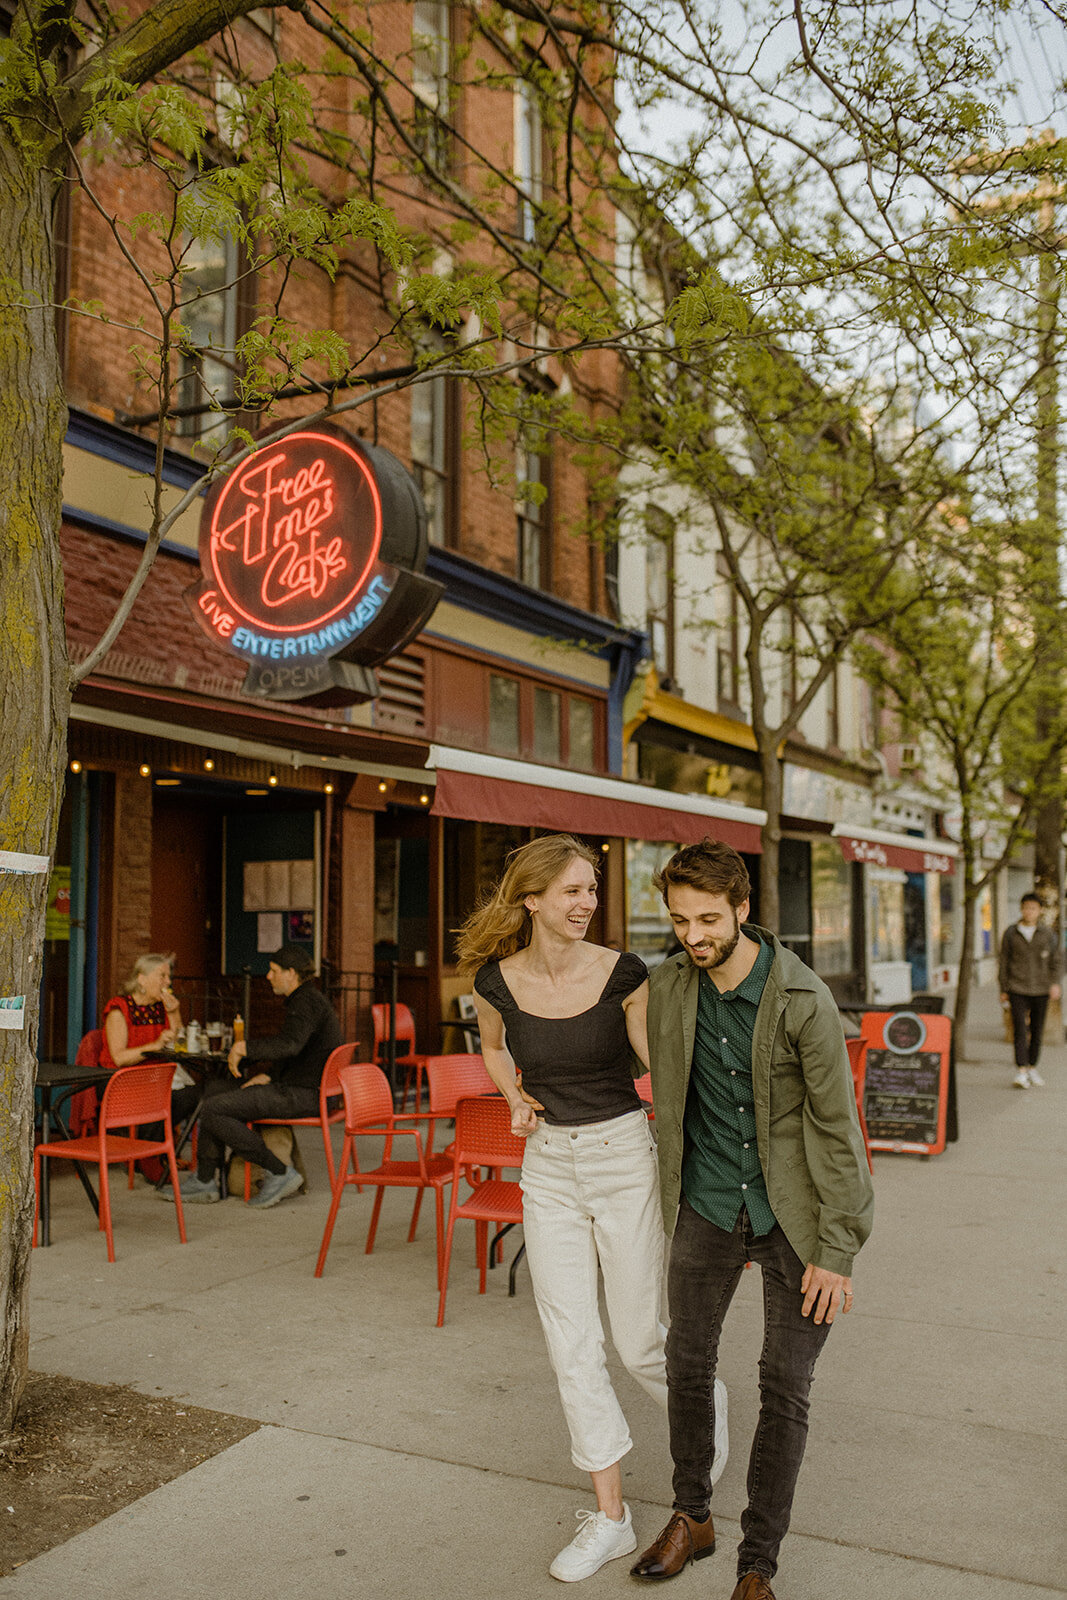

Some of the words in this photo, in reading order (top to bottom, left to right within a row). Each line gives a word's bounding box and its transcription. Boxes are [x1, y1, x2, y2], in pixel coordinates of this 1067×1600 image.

[239, 453, 332, 505] Free
[199, 590, 236, 637] LIVE
[231, 574, 392, 659] ENTERTAINMENT
[259, 665, 321, 688] OPEN
